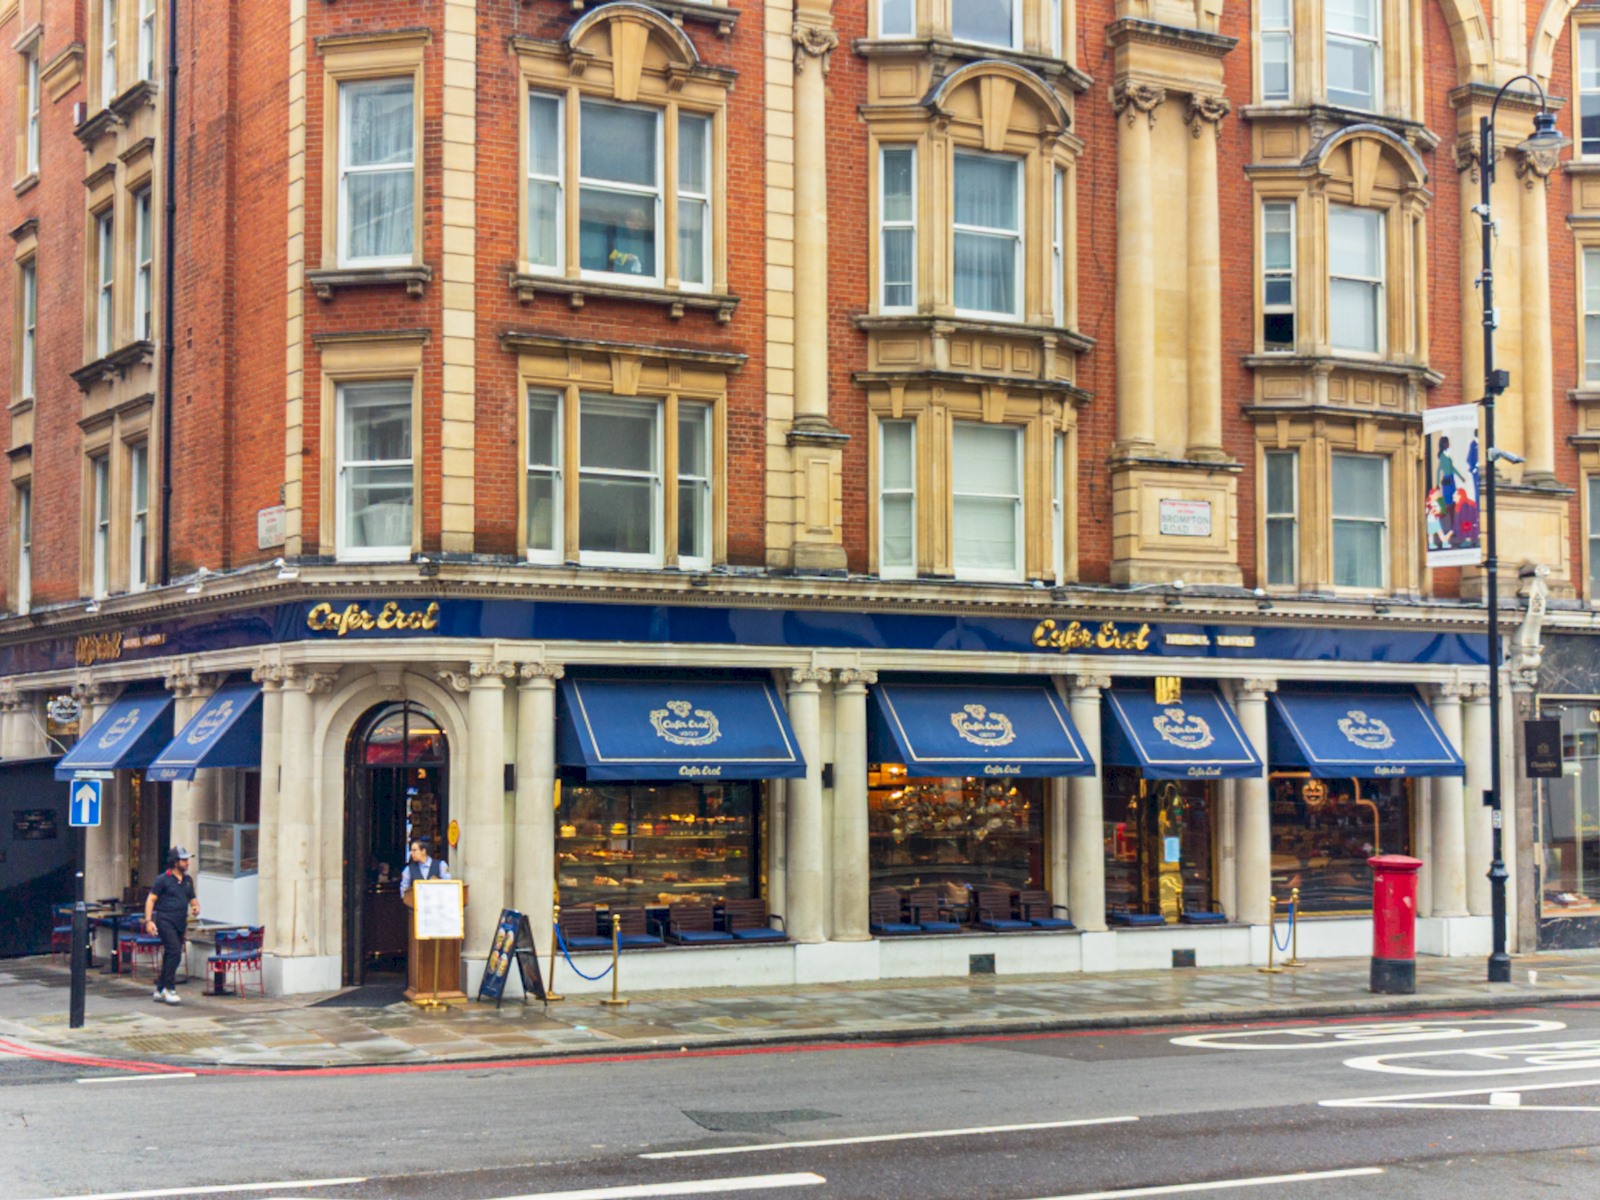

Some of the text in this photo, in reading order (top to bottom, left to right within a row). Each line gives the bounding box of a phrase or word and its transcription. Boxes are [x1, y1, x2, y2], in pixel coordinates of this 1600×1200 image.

[1162, 515, 1208, 525] BROMPTON
[1163, 524, 1189, 533] ROAD
[377, 600, 440, 631] Erol
